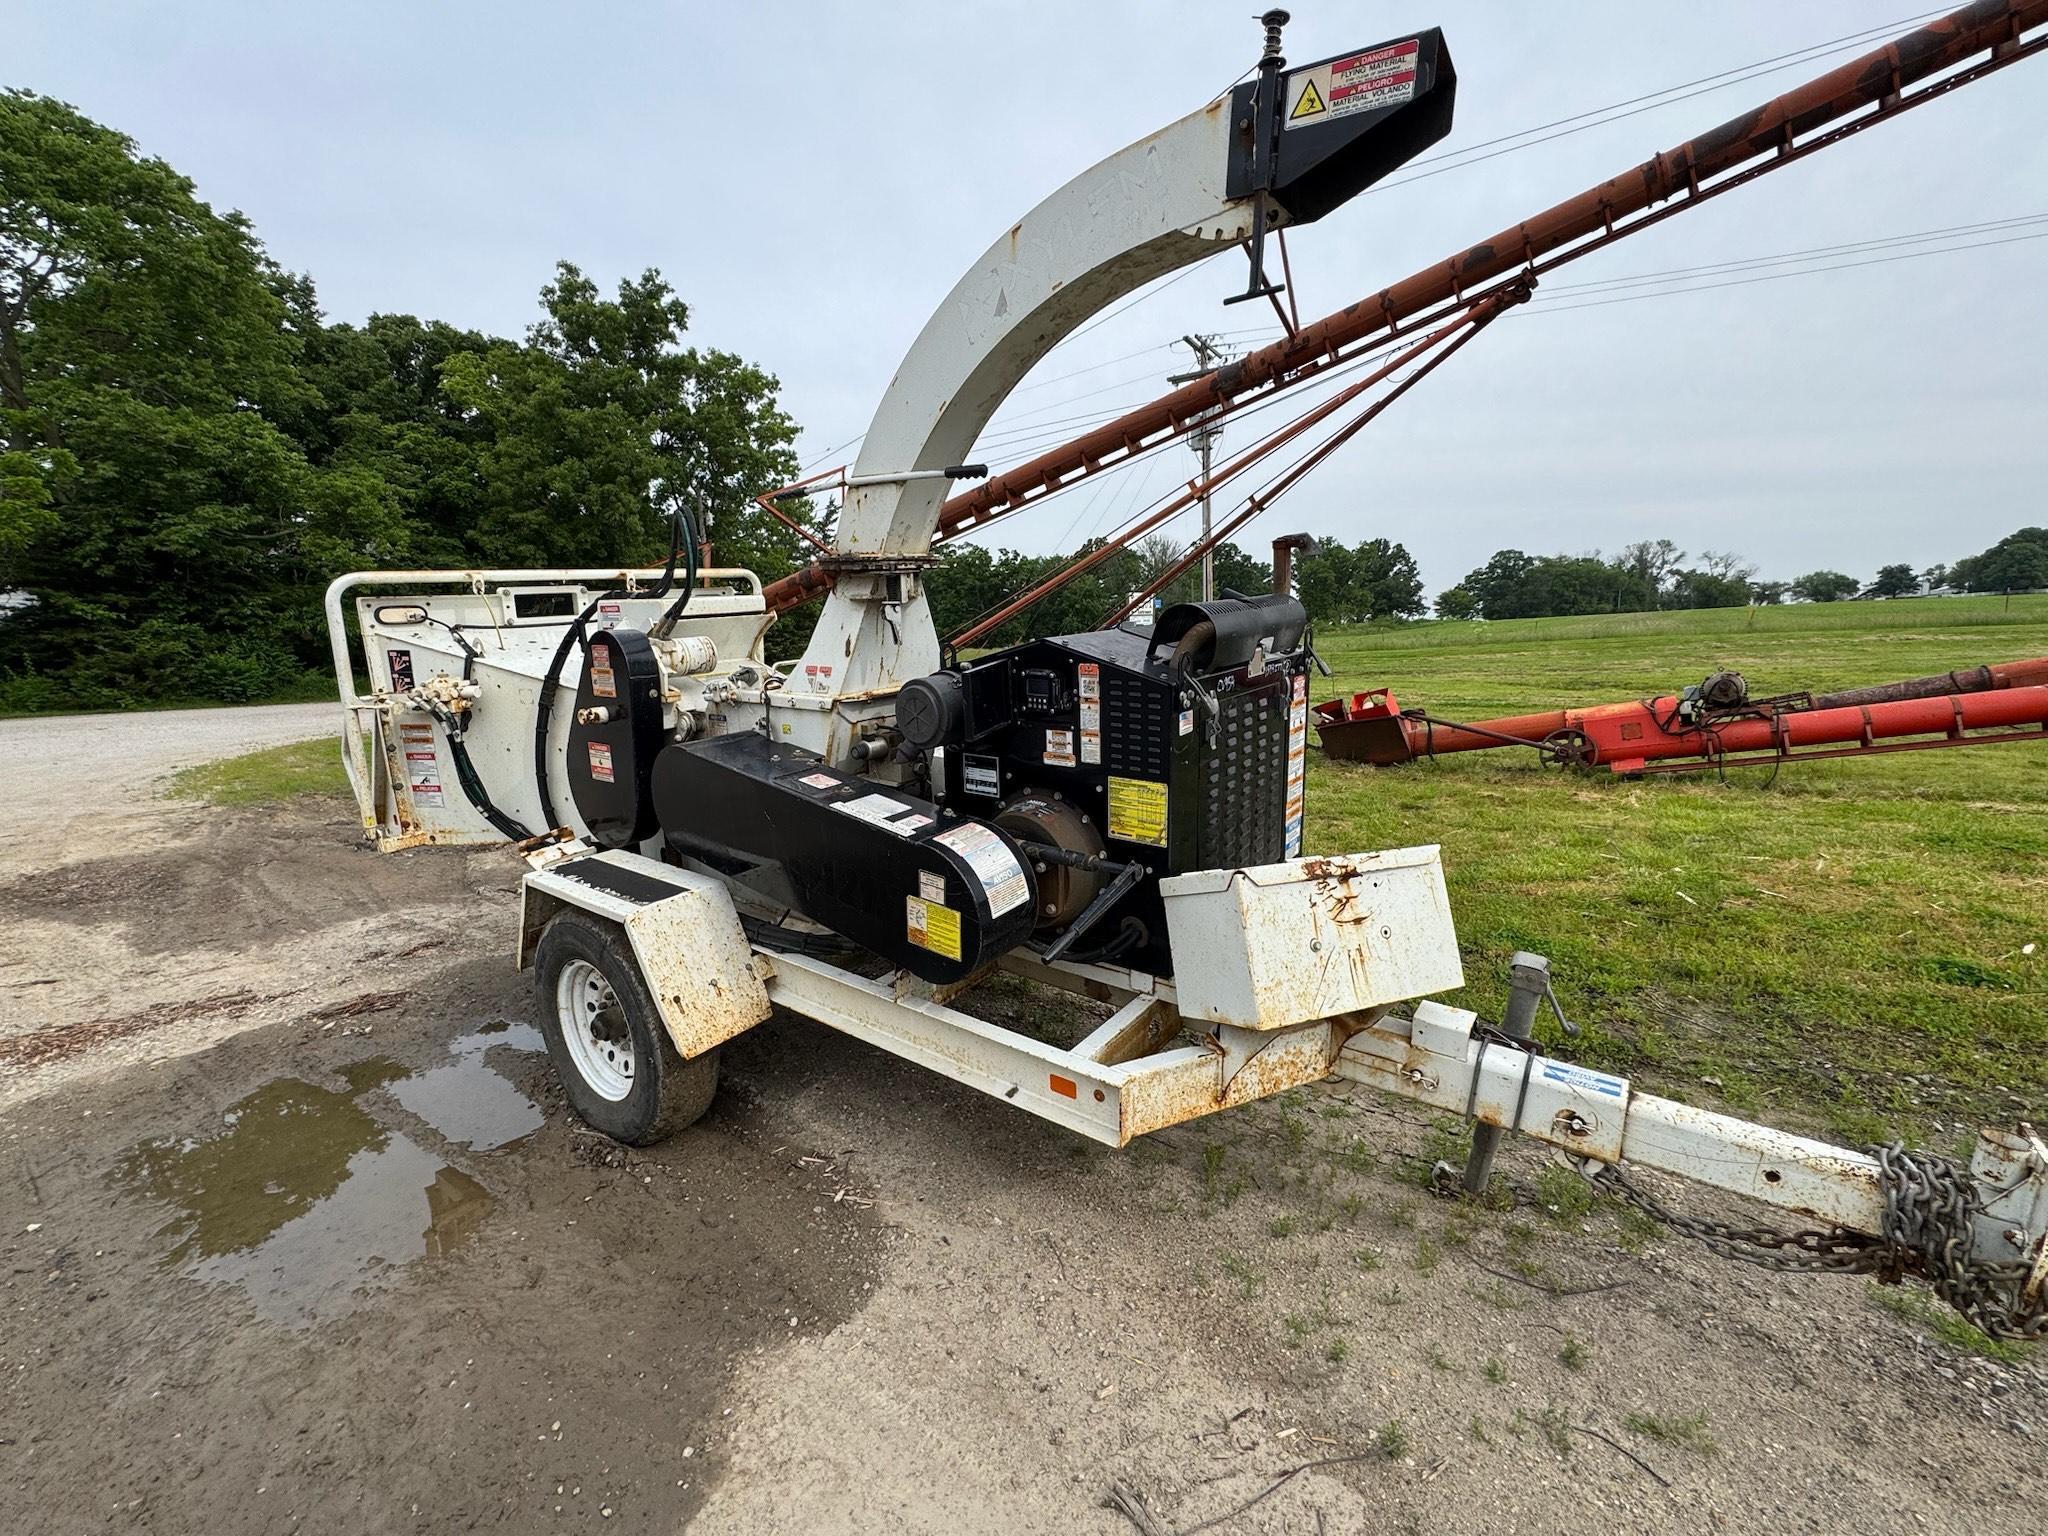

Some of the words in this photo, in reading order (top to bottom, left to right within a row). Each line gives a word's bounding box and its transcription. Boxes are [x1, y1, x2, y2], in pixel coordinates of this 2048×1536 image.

[1361, 49, 1395, 65] DANGER
[1340, 66, 1367, 79] FLYING
[1369, 56, 1407, 71] MATERIAL
[1357, 78, 1393, 93] PELIGRO
[1332, 94, 1369, 108] MATERIAL
[1372, 83, 1411, 98] VOLANDO
